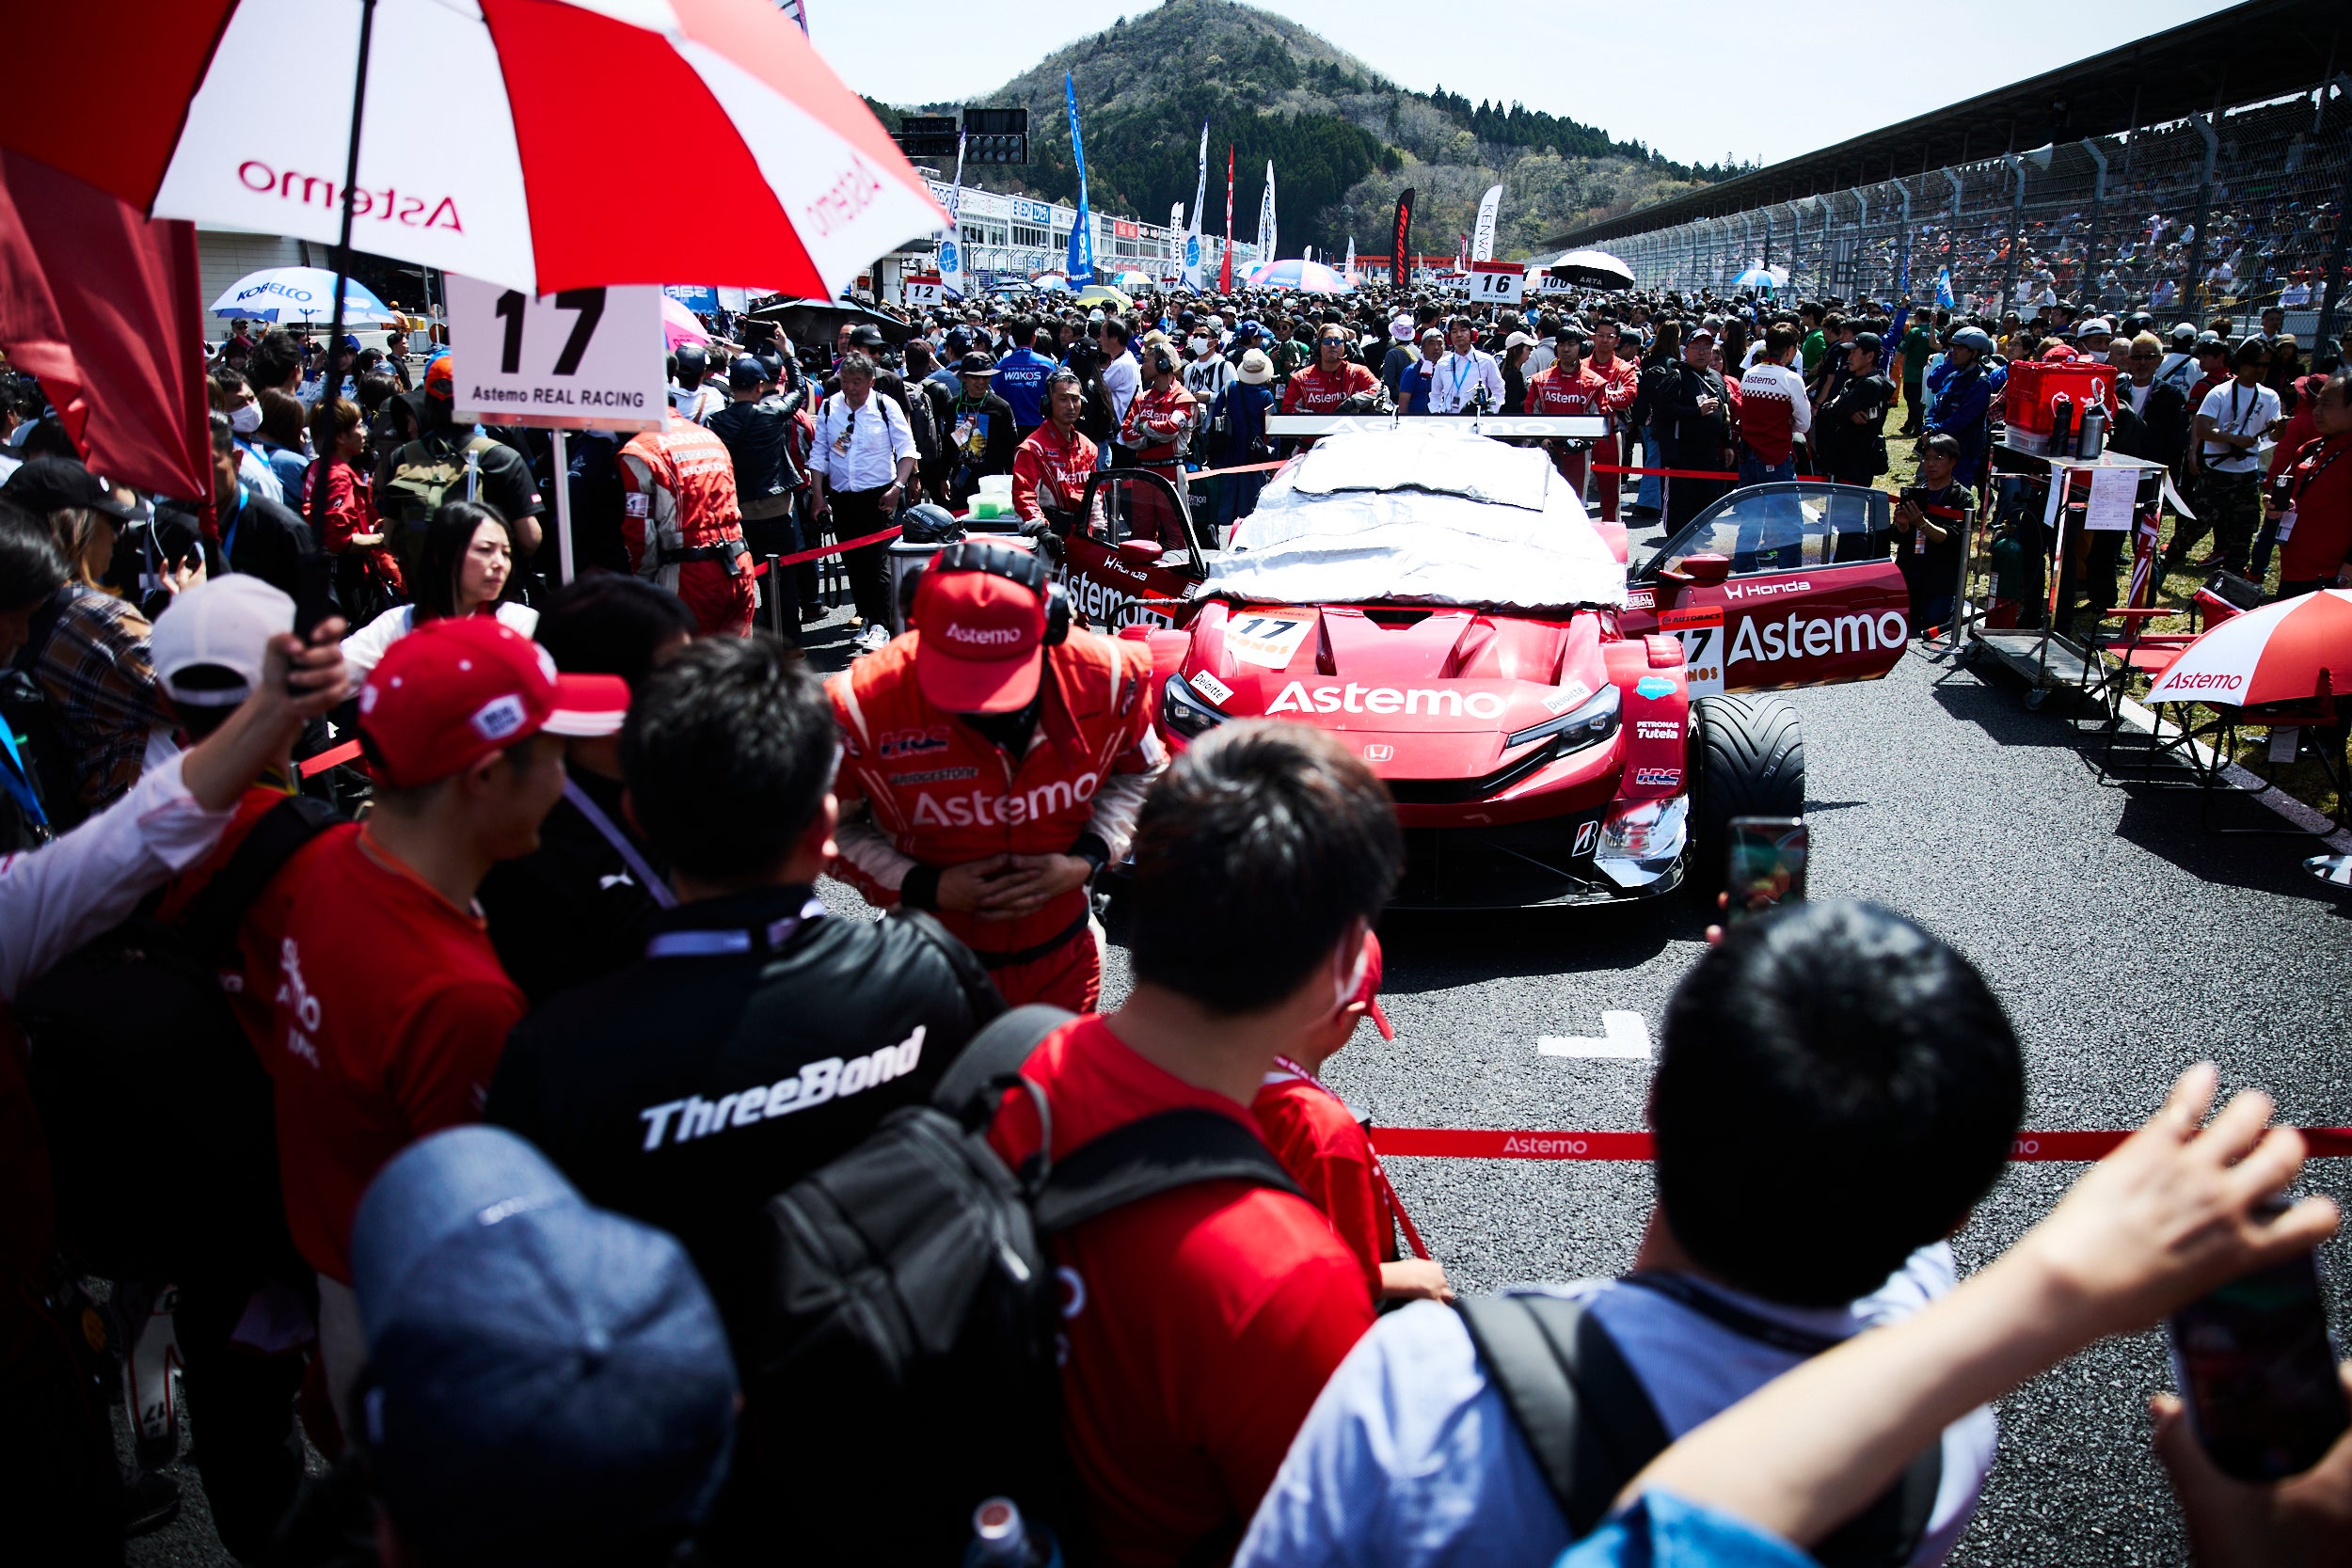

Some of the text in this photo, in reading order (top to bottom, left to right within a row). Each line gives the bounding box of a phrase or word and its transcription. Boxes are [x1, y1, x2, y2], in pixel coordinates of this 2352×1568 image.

[1397, 203, 1408, 285] Modulo
[236, 281, 312, 302] KOBELCO
[914, 284, 934, 299] 12
[1483, 274, 1511, 293] 16
[1580, 277, 1602, 286] ARTA
[495, 286, 608, 376] 17
[1744, 374, 1777, 386] Astemo
[472, 386, 644, 408] Astemo REAL RACING
[1308, 391, 1347, 404] Astemo
[1545, 390, 1587, 404] Astemo
[1318, 415, 1557, 436] Astemo
[1055, 562, 1143, 626] Astemo
[1746, 579, 1812, 597] Honda
[1672, 612, 1722, 624] AUTOBACS
[946, 623, 1022, 645] Astemo
[1239, 618, 1298, 640] 17
[1727, 610, 1909, 667] Astemo
[1195, 673, 1225, 700] Deloitte
[2163, 672, 2243, 690] Astemo
[1264, 680, 1507, 720] Astemo
[1547, 686, 1587, 711] Deloitte
[1636, 721, 1680, 729] PETRONAS
[1637, 728, 1678, 739] Tutela
[1636, 768, 1681, 782] HRC
[912, 771, 1099, 827] Astemo
[639, 1023, 928, 1152] ThreeBond
[1502, 1134, 1588, 1155] Astemo
